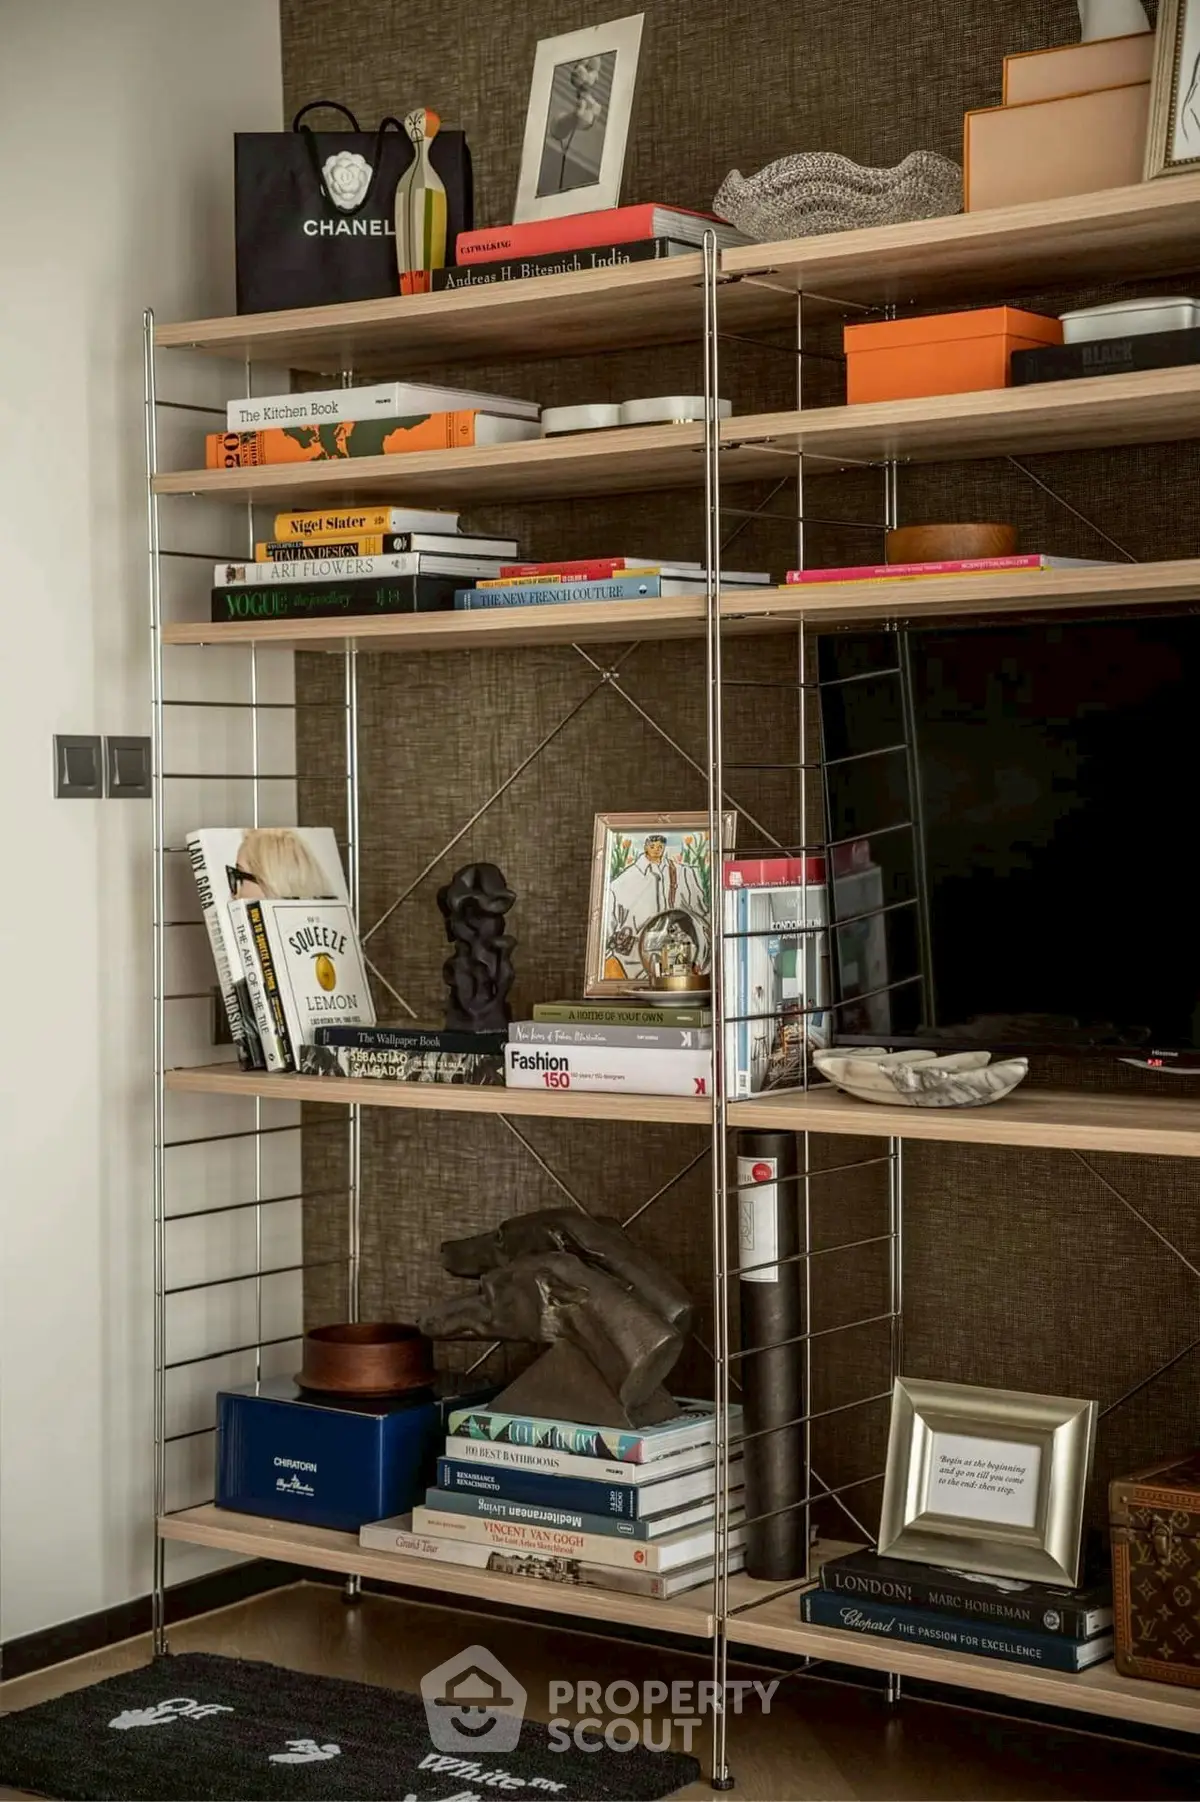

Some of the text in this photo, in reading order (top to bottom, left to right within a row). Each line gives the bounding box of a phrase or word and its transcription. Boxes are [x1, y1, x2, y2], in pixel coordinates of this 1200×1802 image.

[303, 219, 396, 236] CHANEL
[460, 240, 511, 255] CATWALKING
[445, 265, 496, 290] Andreas
[501, 266, 517, 281] H.
[521, 255, 581, 279] Bitesnich
[591, 248, 631, 269] India
[239, 400, 339, 423] The Kitchen Book
[290, 518, 323, 537] Nigel
[325, 515, 366, 531] Slater
[275, 547, 316, 562] ITALIAN
[318, 544, 357, 560] DESIGN
[271, 558, 374, 579] ART FLOWERS
[225, 591, 288, 617] VOGUE
[480, 594, 501, 607] THE
[501, 592, 527, 606] NEW
[529, 589, 571, 604] FRENCH
[573, 585, 624, 601] COUTURE
[187, 839, 206, 872] LADY
[196, 875, 215, 910] GAGA
[288, 926, 347, 956] SQUEEZE
[256, 934, 270, 962] SQUEEZE
[263, 970, 275, 991] LEMON
[236, 925, 270, 1034] THE ART OF THE TILE
[306, 994, 358, 1011] LEMON
[568, 1010, 575, 1020] A
[642, 1012, 664, 1022] OWN
[357, 1031, 440, 1047] The Wallpaper Book
[353, 1063, 405, 1076] SALGADO
[511, 1051, 569, 1071] Fashion
[542, 1072, 570, 1088] 150
[465, 1445, 560, 1469] 100 BEST BATHROOMS
[973, 1459, 986, 1467] the
[987, 1460, 1026, 1475] beginning
[456, 1471, 495, 1484] RENAISSANCE
[456, 1478, 500, 1491] RENACIMIENTO
[938, 1477, 946, 1485] to
[947, 1478, 959, 1487] the
[978, 1481, 996, 1492] then
[939, 1466, 954, 1475] and
[955, 1470, 965, 1478] go
[976, 1470, 989, 1479] till
[989, 1474, 1004, 1482] you
[1005, 1477, 1024, 1485] come
[478, 1497, 582, 1528] Mediterranean Living
[395, 1536, 438, 1553] Grand Tour
[483, 1521, 526, 1538] VINCENT
[530, 1528, 551, 1541] VAN
[553, 1533, 584, 1548] GOGH
[491, 1534, 504, 1543] The
[537, 1540, 573, 1554] Sketchbook
[835, 1573, 1031, 1621] LONDON! MARC HOBERMAN
[839, 1607, 1042, 1659] Chopard THE PASSION FOR EXCELLENCE
